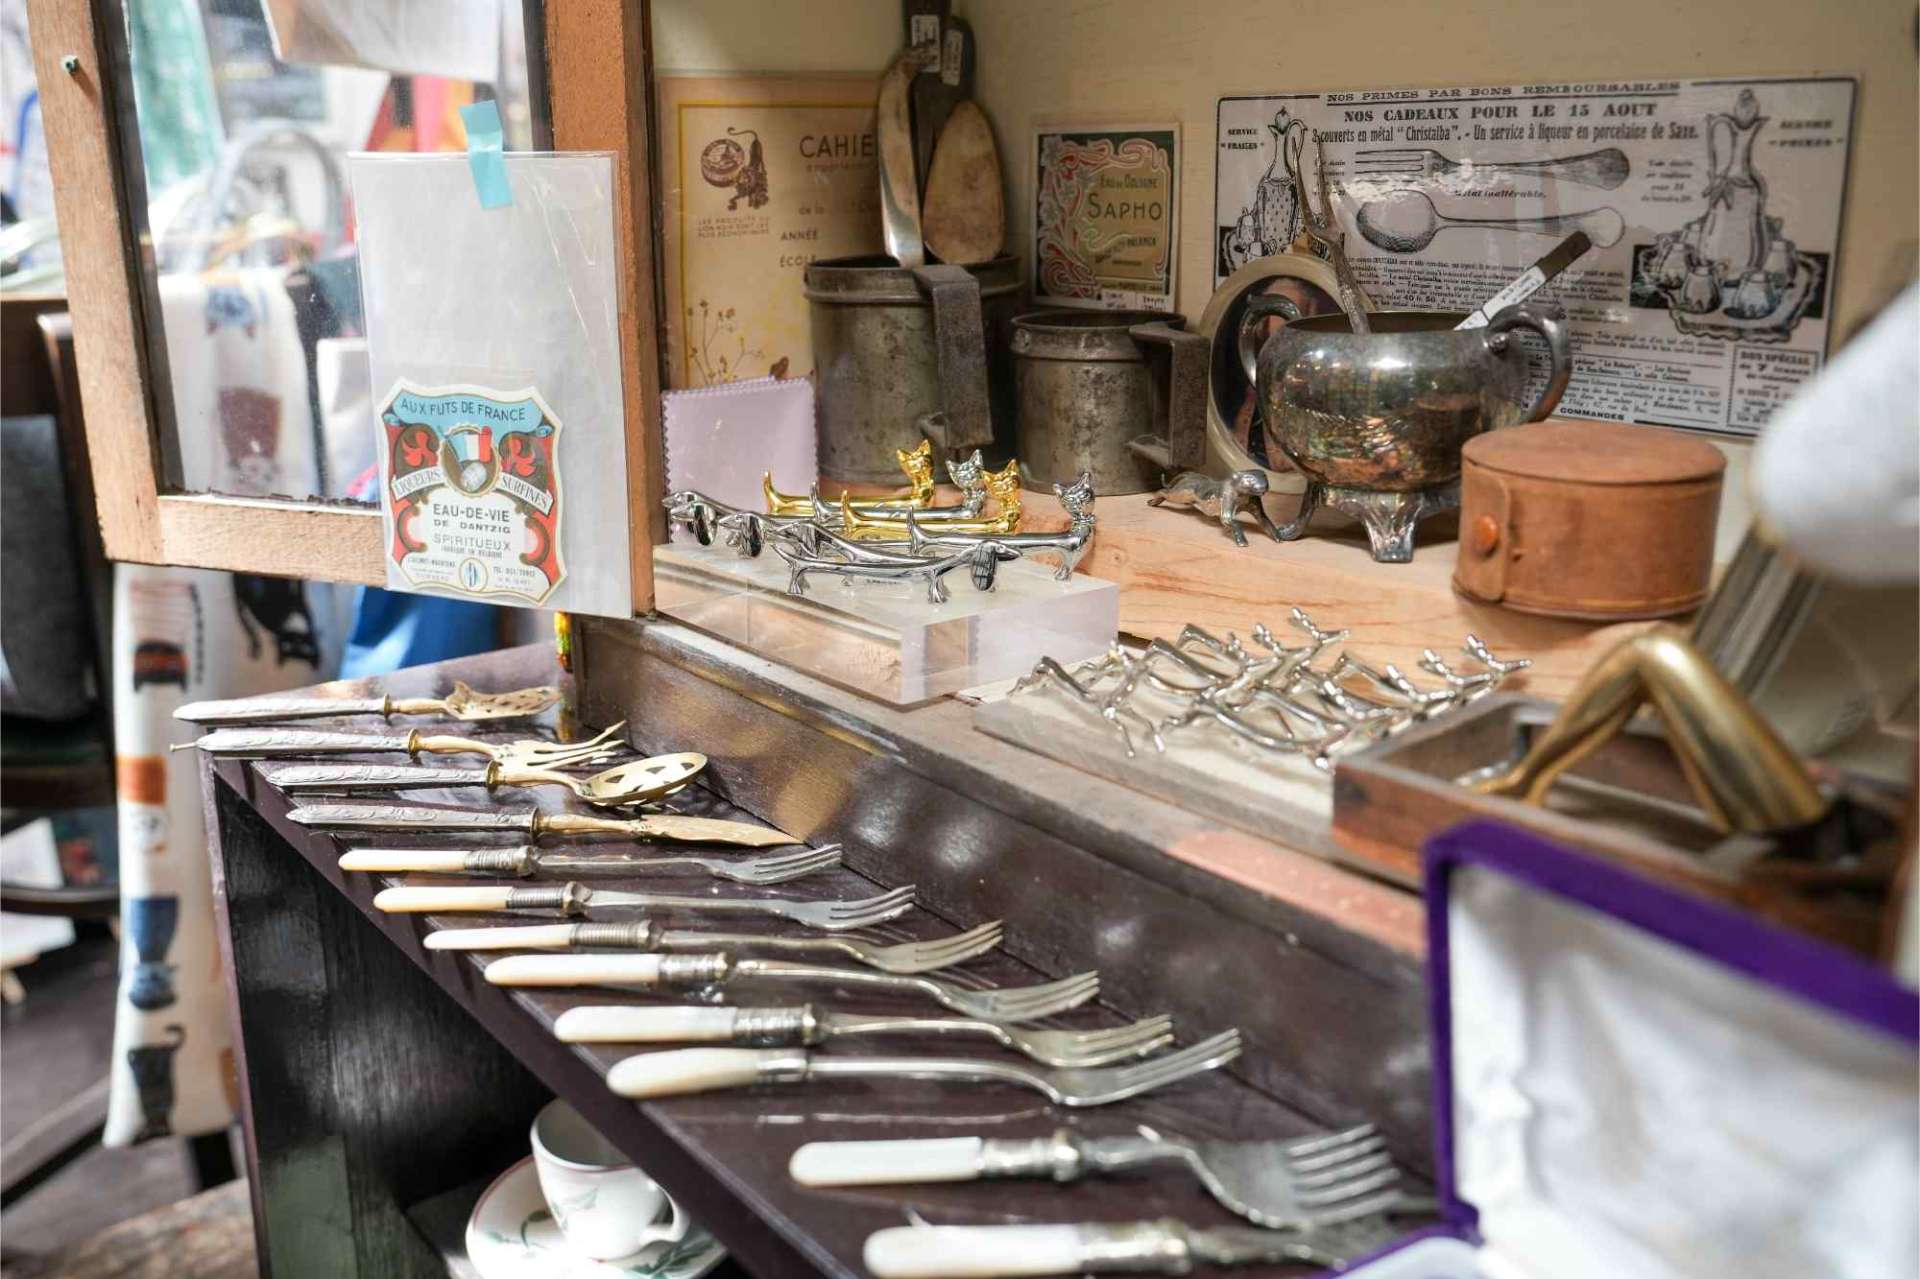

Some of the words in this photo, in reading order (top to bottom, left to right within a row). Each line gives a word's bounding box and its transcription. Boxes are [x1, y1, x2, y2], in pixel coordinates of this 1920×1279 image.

[1327, 93, 1354, 102] NOS
[1361, 90, 1418, 101] PRIMES
[1428, 88, 1461, 98] PAR
[1469, 87, 1512, 96] BONS
[1523, 81, 1681, 94] REMBOURSABLES
[1344, 110, 1374, 122] NOS
[1383, 107, 1459, 121] CADEAUX
[1470, 105, 1518, 119] POUR
[1532, 104, 1555, 117] LE
[1569, 104, 1590, 117] 15
[1602, 103, 1657, 117] AOUT
[1320, 128, 1355, 143] couverts
[1357, 130, 1367, 143] en
[1370, 126, 1393, 142] métal
[1474, 124, 1486, 140] Un
[1490, 122, 1524, 140] service
[1528, 122, 1534, 139] à
[1538, 122, 1573, 143] liqueur
[1576, 125, 1589, 139] en
[1593, 122, 1647, 143] porcelaine
[1651, 121, 1664, 139] de
[799, 134, 874, 159] CAHIE
[401, 398, 427, 414] AUX
[461, 401, 474, 415] DE
[478, 403, 525, 421] FRANCE
[1560, 407, 1625, 420] COMMANDES
[503, 477, 547, 508] SURFINES
[433, 503, 510, 522] EAU-DE-VIE
[434, 519, 448, 527] DE
[460, 521, 511, 534] DANTZIG
[433, 532, 511, 551] SPIRITUEUX
